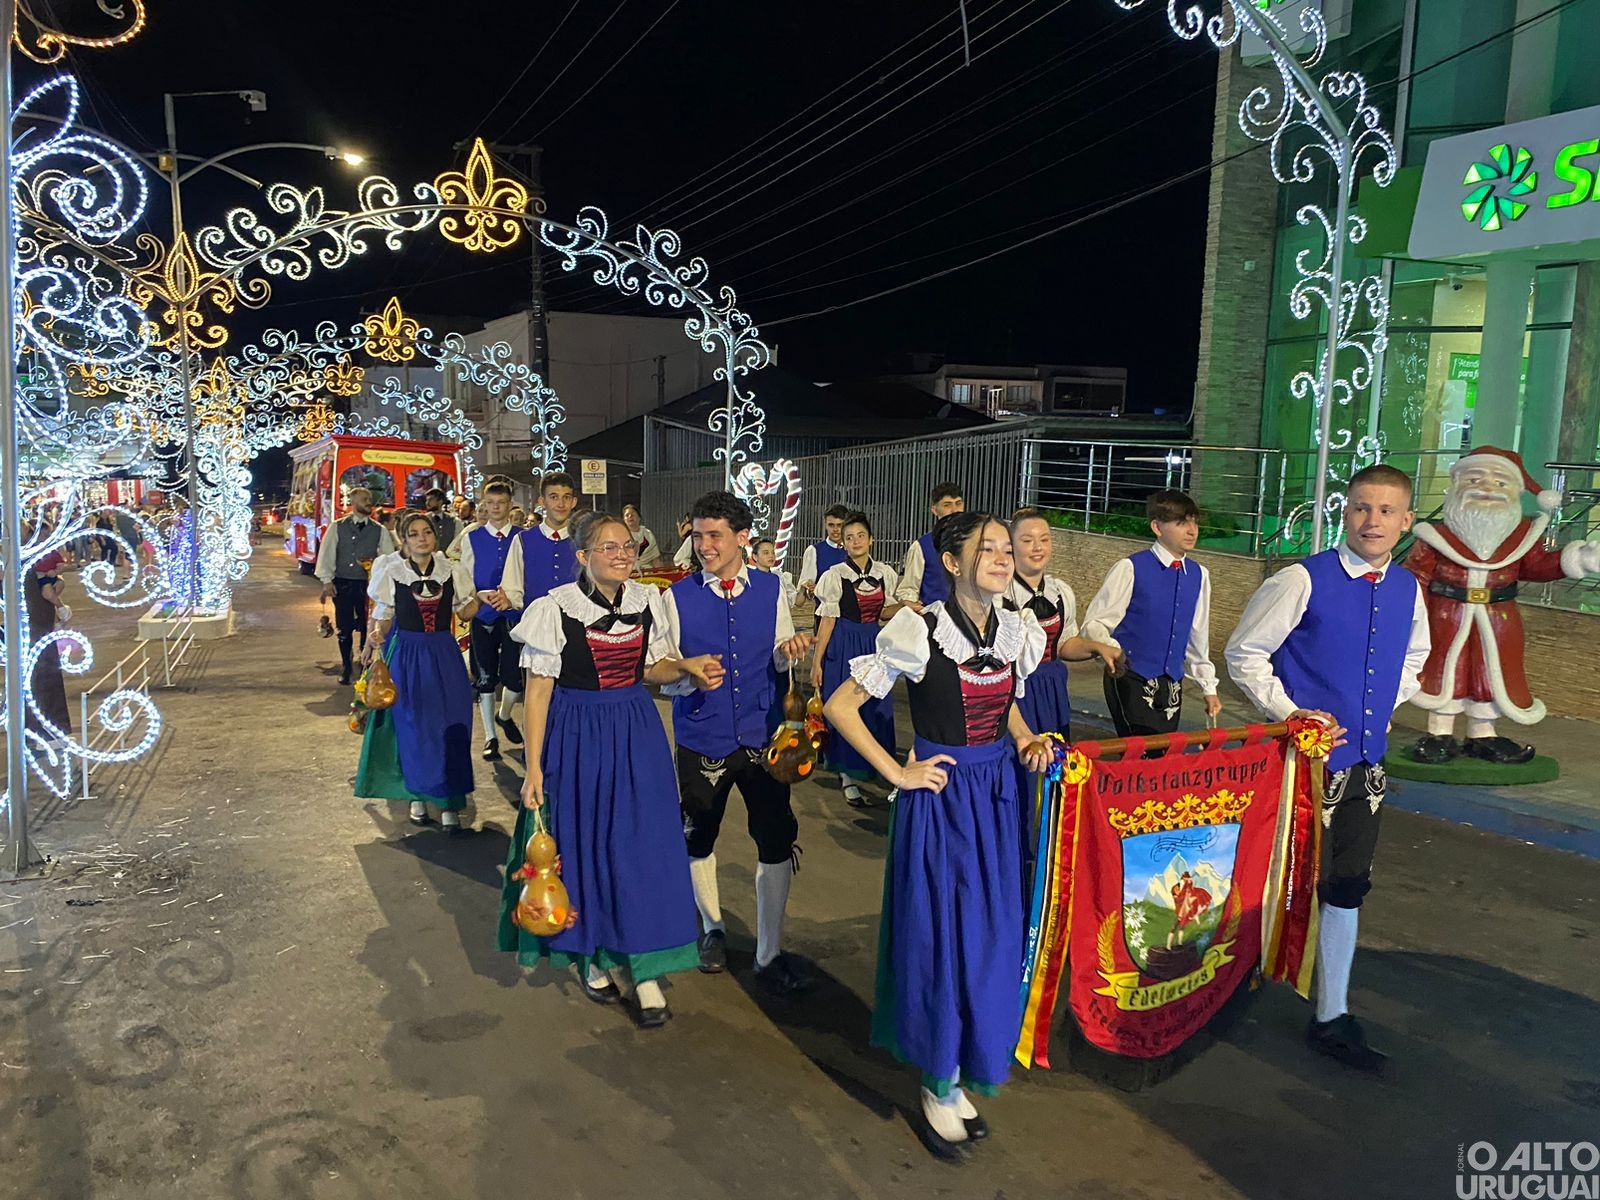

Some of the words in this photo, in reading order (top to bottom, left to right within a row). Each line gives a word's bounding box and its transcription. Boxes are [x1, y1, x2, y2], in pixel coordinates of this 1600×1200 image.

[1545, 138, 1600, 209] S
[1096, 756, 1268, 796] Volkstanzgruppe
[1128, 968, 1209, 1008] Edelweiss
